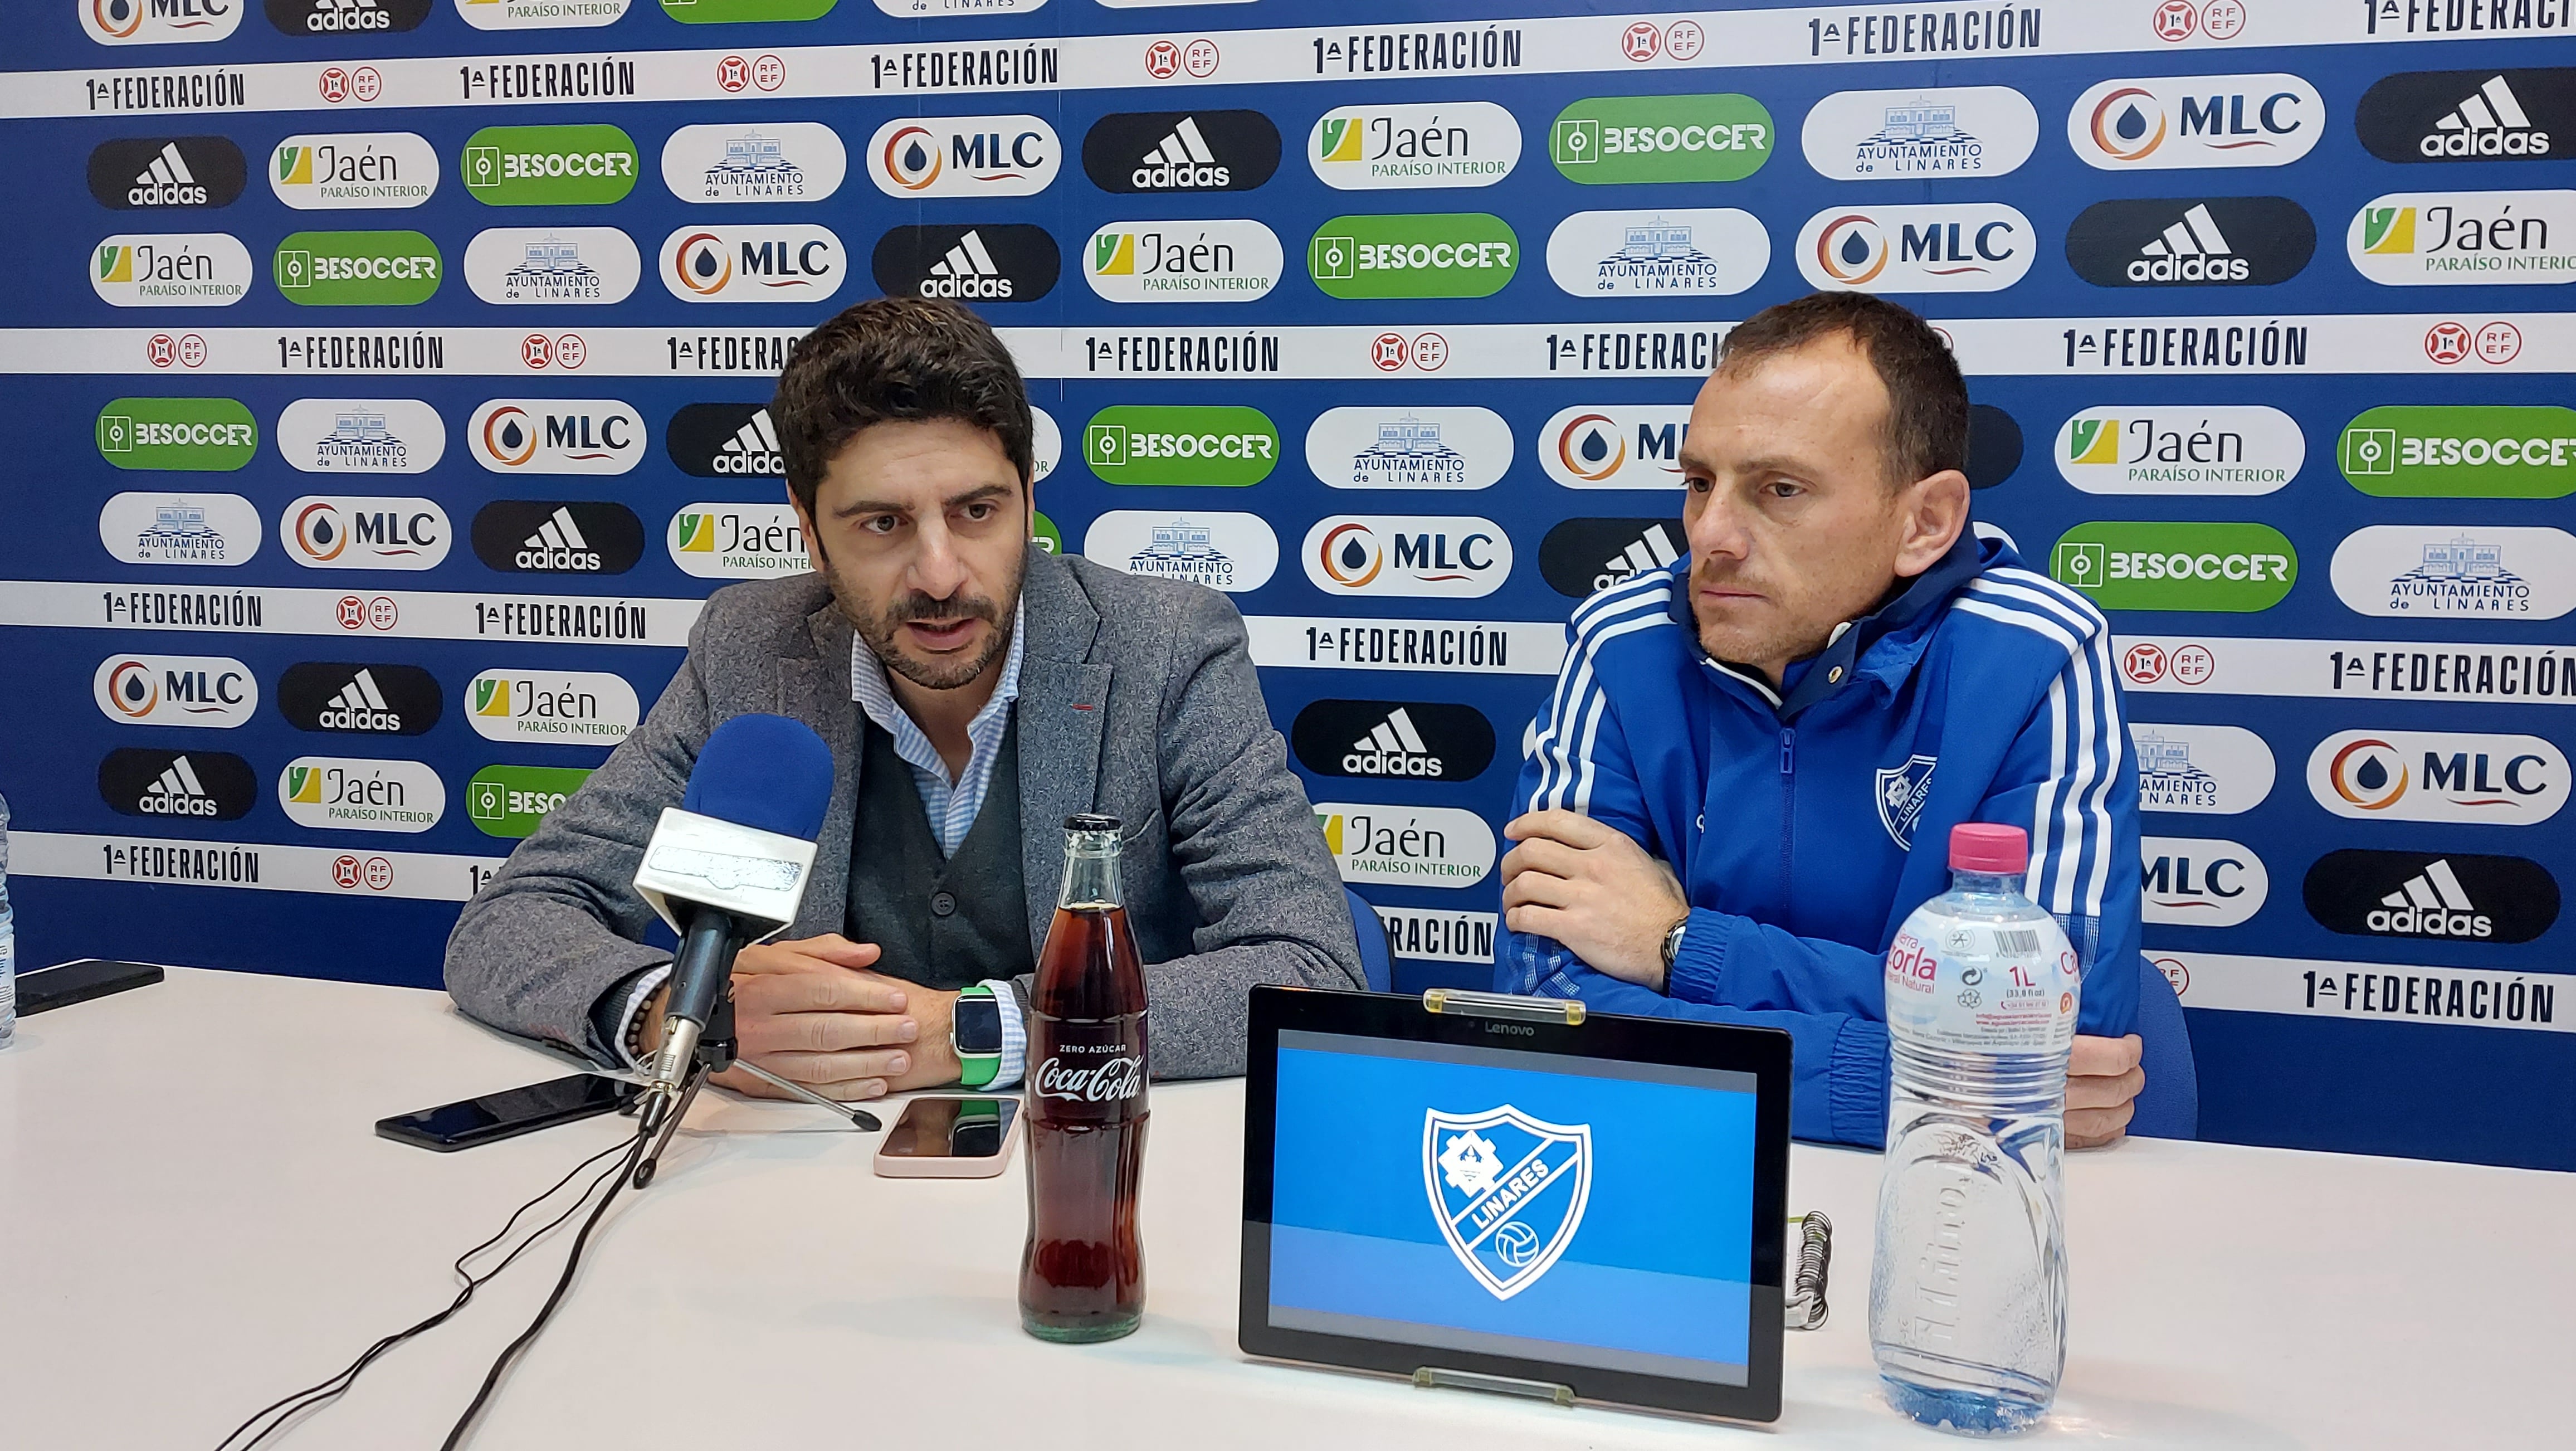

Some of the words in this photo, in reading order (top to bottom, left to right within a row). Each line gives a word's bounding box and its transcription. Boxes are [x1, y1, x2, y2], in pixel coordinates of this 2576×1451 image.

[507, 0, 559, 18] PARAÍSO
[563, 3, 621, 16] INTERIOR
[913, 0, 926, 10] de
[2408, 0, 2569, 32] FEDERACI
[308, 7, 389, 31] adidas
[1848, 3, 2040, 55] FEDERACIÓN
[1349, 25, 1520, 72] FEDERACIÓN
[490, 56, 633, 98] FEDERACIÓN
[904, 43, 1057, 87] FEDERACIÓN
[114, 69, 244, 109] FEDERACIÓN
[2181, 93, 2301, 136] MLC
[1372, 116, 1467, 160] Jaén
[1604, 124, 1765, 153] BESOCCER
[2421, 125, 2549, 156] adidas
[953, 132, 1043, 169] MLC
[1857, 144, 1981, 159] AYUNTAMIENTO
[319, 145, 396, 183] Jaén
[505, 153, 631, 177] BESOCCER
[1373, 160, 1432, 176] PARAÍSO
[1438, 162, 1506, 174] INTERIOR
[1856, 162, 1873, 172] de
[1896, 158, 1980, 171] LINARES
[706, 173, 803, 185] AYUNTAMIENTO
[1133, 167, 1229, 187] adidas
[129, 182, 207, 204] adidas
[321, 184, 369, 198] PARAÍSO
[373, 186, 428, 197] INTERIOR
[706, 187, 719, 196] de
[736, 185, 803, 196] LINARES
[2427, 206, 2546, 253] Jaén
[1143, 233, 1232, 274] Jaén
[1901, 222, 2013, 262] MLC
[138, 245, 212, 281] Jaén
[315, 257, 436, 279] BESOCCER
[742, 241, 829, 275] MLC
[1360, 243, 1510, 269] BESOCCER
[2427, 253, 2501, 271] PARAÍSO
[2508, 256, 2576, 270] INTERIO
[506, 276, 599, 286] AYUNTAMIENTO
[1599, 264, 1716, 276] AYUNTAMIENTO
[2128, 259, 2248, 281] adidas
[140, 283, 186, 295] PARAÍSO
[190, 285, 242, 295] INTERIOR
[506, 289, 519, 298] de
[536, 288, 599, 298] LINARES
[920, 274, 1012, 298] adidas
[1144, 275, 1200, 290] PARAÍSO
[1205, 277, 1269, 290] INTERIOR
[1598, 279, 1614, 289] de
[1636, 276, 1716, 289] LINARES
[306, 331, 443, 368] FEDERACIÓN
[697, 337, 798, 370] FEDERA
[1119, 331, 1278, 372] FEDERACIÓN
[1583, 333, 1718, 369] FEDERACI
[2104, 320, 2307, 366] FEDERACIÓN
[136, 423, 252, 445] BESOCCER
[1131, 434, 1271, 458] BESOCCER
[2129, 420, 2242, 464] Jaén
[318, 446, 406, 456] AYUNTAMIENTO
[318, 457, 329, 466] de
[345, 457, 406, 467] LINARES
[713, 451, 786, 474] adida
[1354, 459, 1463, 470] AYUNTAMIENTO
[2129, 465, 2199, 481] PARAÍSO
[2206, 469, 2286, 481] INTERIOR
[1354, 472, 1368, 482] de
[1388, 472, 1463, 482] LINARES
[356, 513, 436, 546] MLC
[721, 515, 805, 553] Jaén
[139, 538, 224, 549] AYUNTAMIENTO
[139, 549, 150, 558] de
[165, 549, 224, 559] LINARES
[1394, 534, 1493, 570] MLC
[516, 547, 600, 569] adidas
[723, 554, 775, 568] PARAÍSO
[1130, 561, 1232, 574] AYUNTAMIENTO
[2110, 553, 2287, 581] BESOCCER
[2392, 584, 2529, 597] AYUNTAMIENTO
[131, 590, 261, 626] FEDERACIÓN
[2390, 597, 2409, 609] de
[2434, 597, 2529, 611] LINARES
[505, 601, 645, 639] FEDERACIÓN
[1340, 625, 1506, 666] FEDERACIÓN
[167, 671, 243, 704] MLC
[516, 681, 596, 720] Jaén
[320, 712, 400, 730] adidas
[518, 719, 568, 733] PARAÍSO
[570, 723, 628, 736] INTERIOR
[547, 416, 630, 449] MLC
[1035, 1055, 1143, 1102] Coca-Cola
[1343, 755, 1442, 776] adidas
[2423, 752, 2546, 795] MLC
[328, 769, 403, 806] Jaén
[2140, 779, 2216, 793] AMIENTO
[139, 797, 217, 815] adidas
[509, 791, 567, 814] BESO
[2140, 792, 2216, 806] INARES
[329, 806, 377, 820] PARAÍSO
[380, 810, 434, 823] INTERIOR
[1352, 816, 1444, 860] Jaén
[130, 846, 258, 883] FEDERACIÓN
[1353, 858, 1410, 873] PARAÍSO
[1416, 863, 1481, 877] INTERIOR
[2141, 856, 2245, 898] MLC
[2367, 907, 2491, 936] adidas
[1390, 916, 1491, 956] RACIÓN
[1902, 976, 1935, 994] Natural
[2009, 966, 2036, 987] 1L
[2345, 974, 2553, 1022] FEDERACIÓN
[1485, 1021, 1534, 1036] Lenovo
[1060, 1044, 1085, 1054] ZERO
[1089, 1043, 1126, 1054] AZÚCAR
[1471, 1159, 1549, 1229] LINARES
